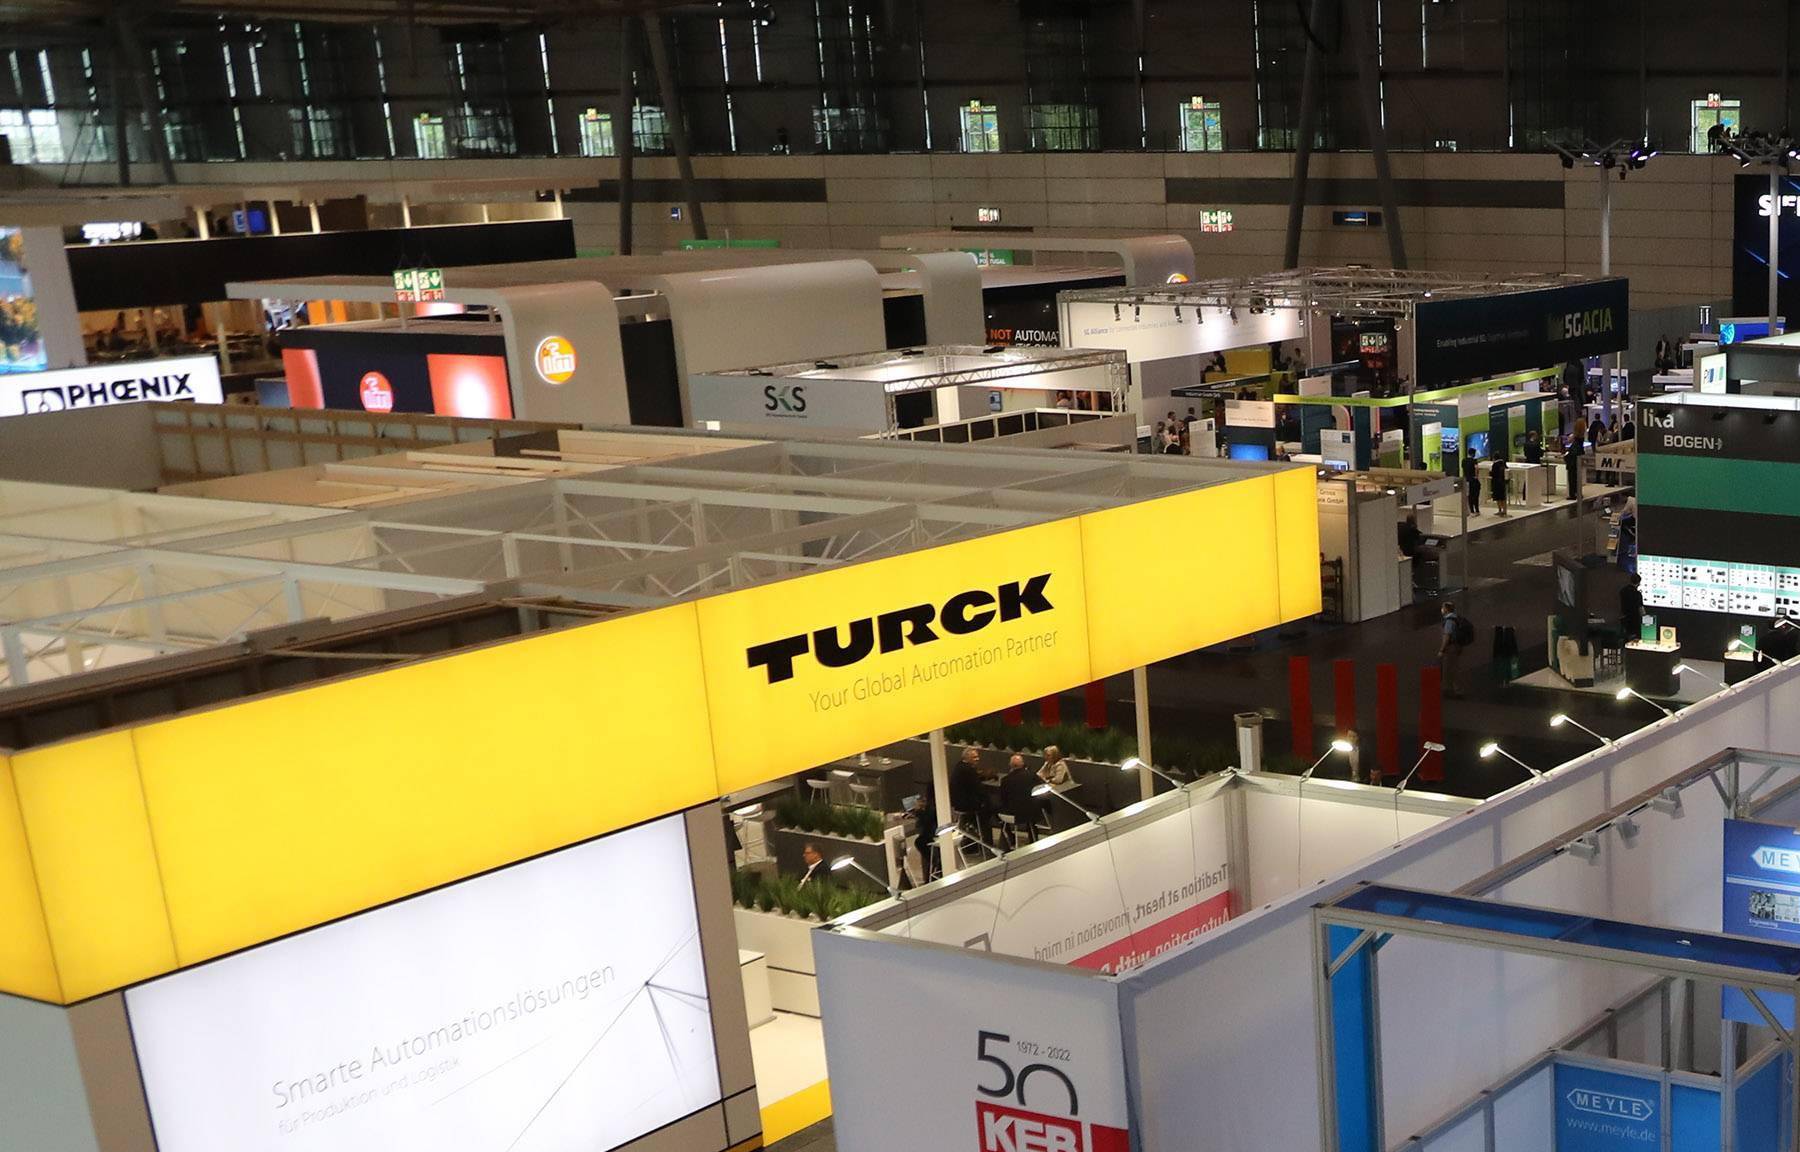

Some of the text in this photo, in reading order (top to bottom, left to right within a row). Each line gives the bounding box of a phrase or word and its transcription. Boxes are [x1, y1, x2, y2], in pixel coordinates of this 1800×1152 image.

[991, 329, 1060, 342] NOT AUTOMA
[764, 385, 806, 412] SKS
[1664, 434, 1715, 450] BOGEN
[746, 572, 1055, 685] TURCK
[808, 629, 1059, 713] Your Global Automation Partner
[272, 963, 616, 1110] Smarte Automationslösungen
[1577, 1093, 1641, 1116] MEYLE
[1566, 1117, 1656, 1142] www.meyle.de
